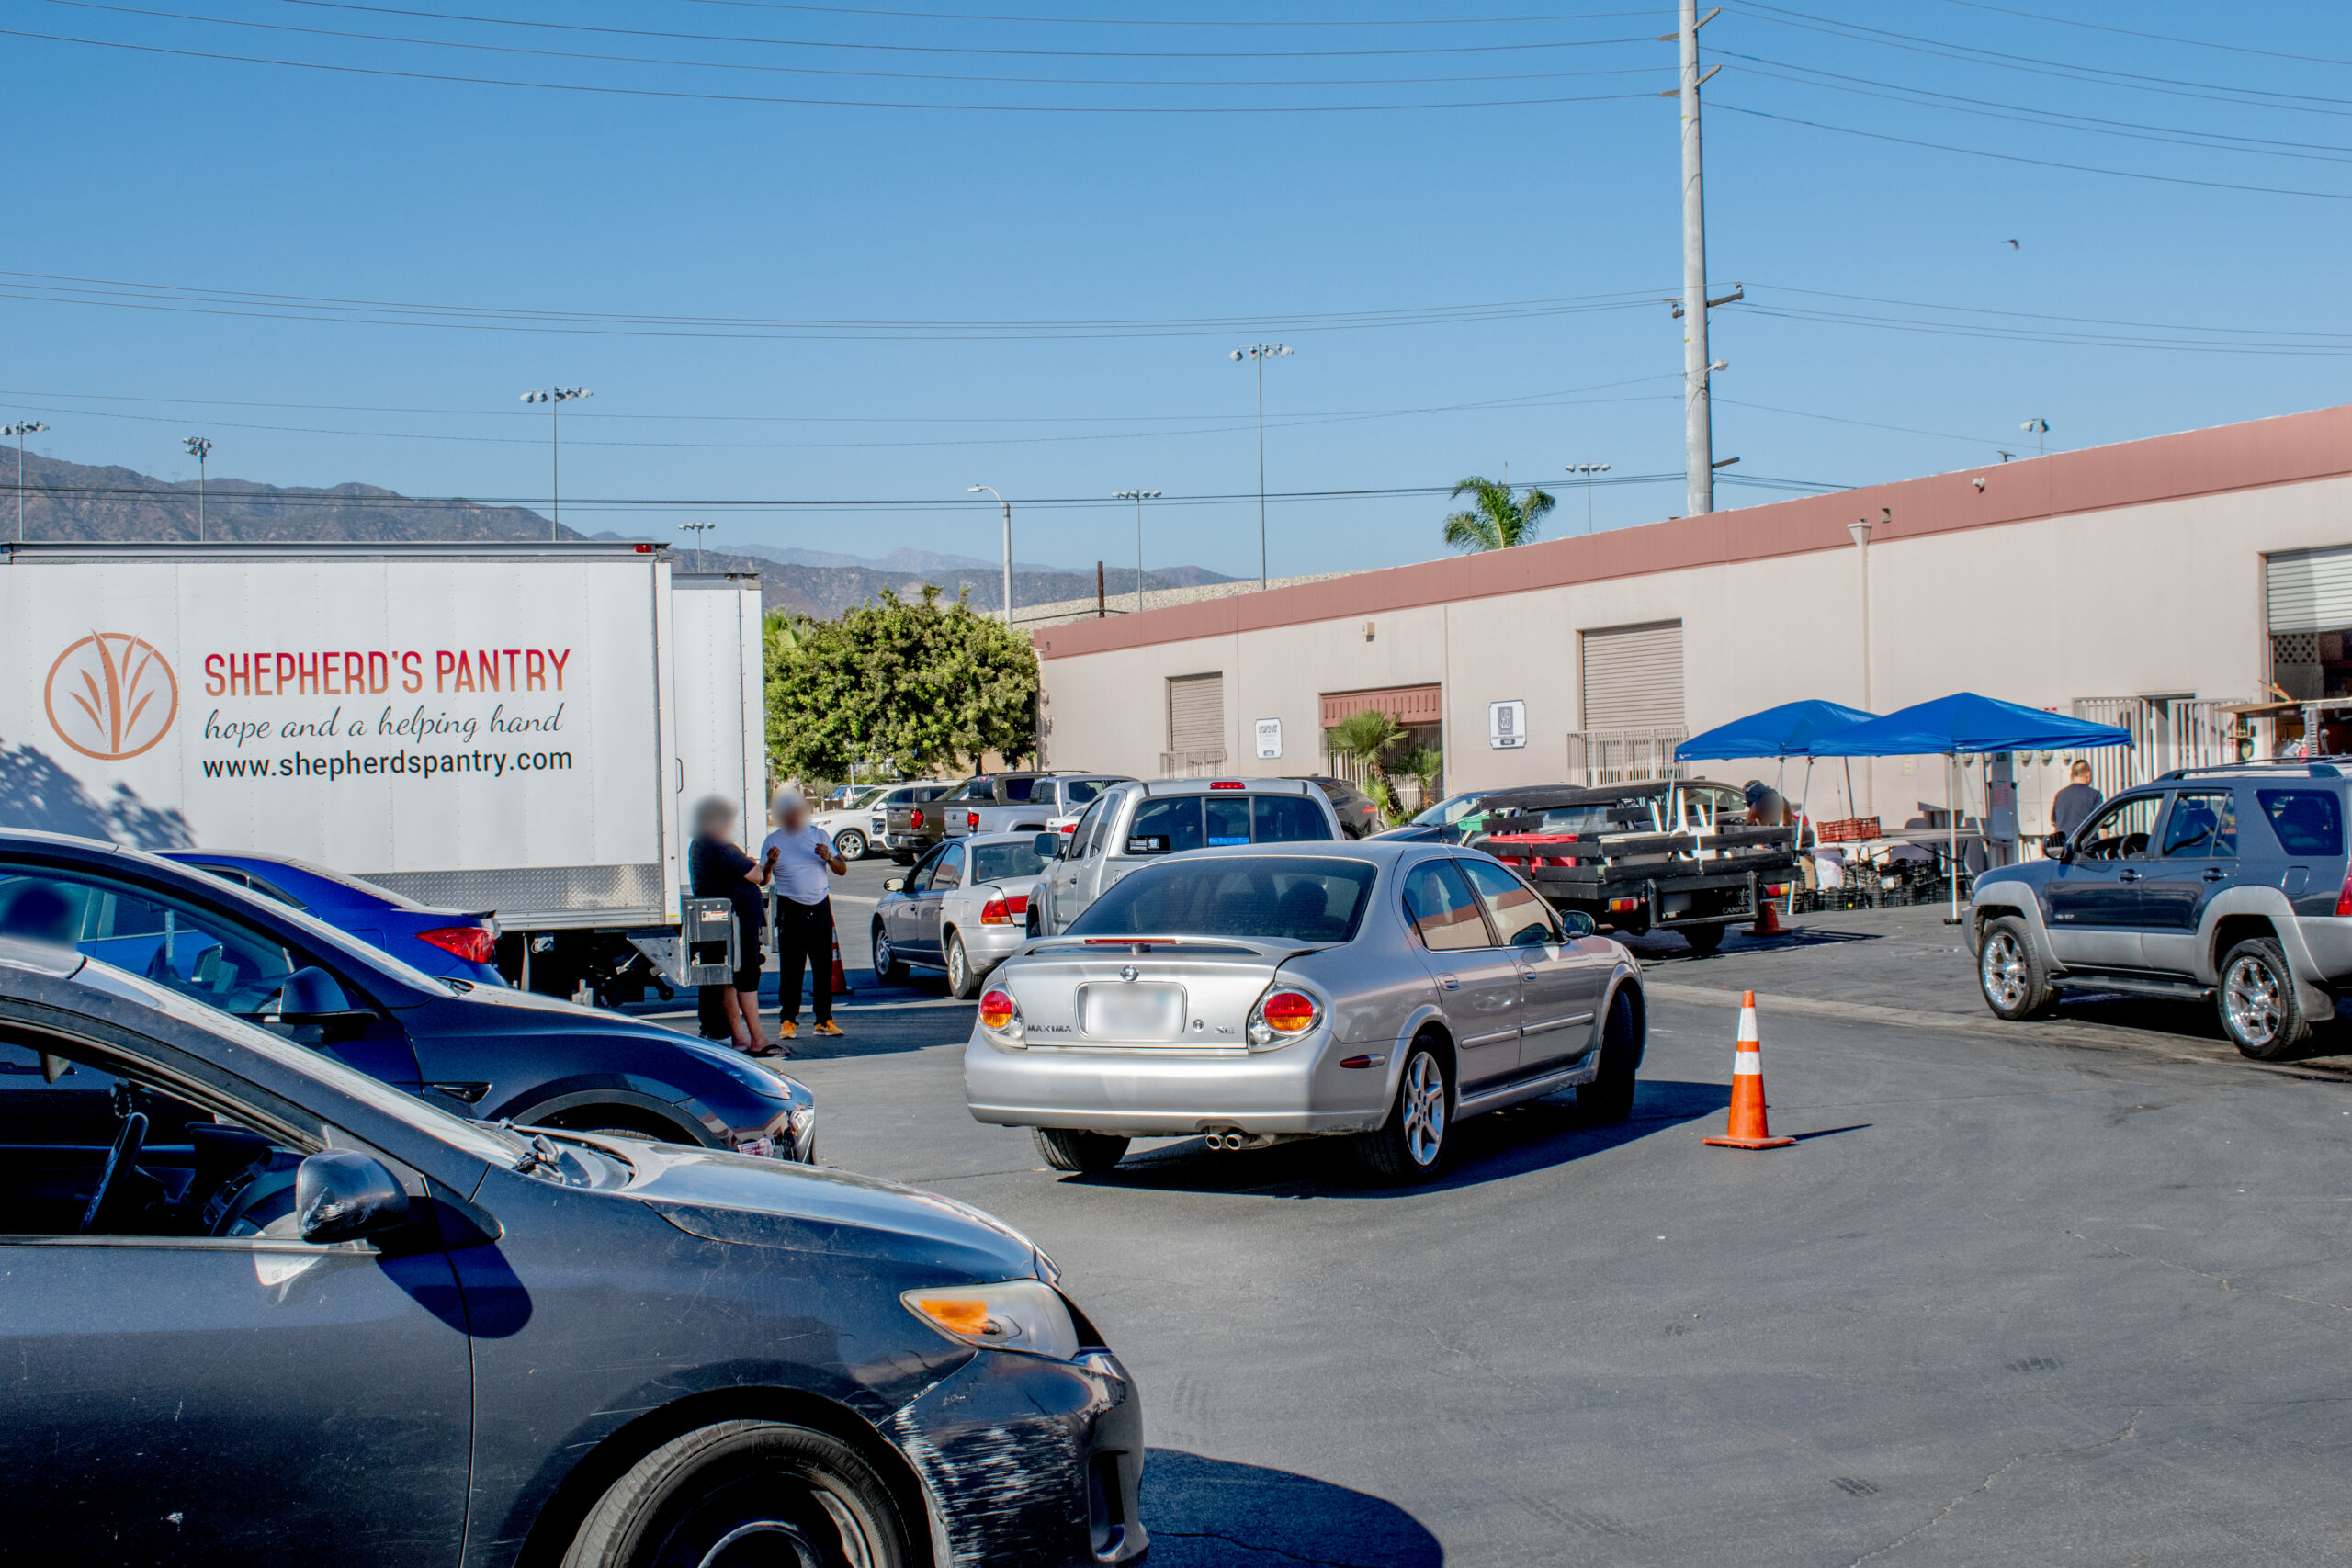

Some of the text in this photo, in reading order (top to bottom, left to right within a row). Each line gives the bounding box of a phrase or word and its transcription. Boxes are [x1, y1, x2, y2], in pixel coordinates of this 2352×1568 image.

[205, 649, 571, 696] SHEPHERD'S PANTRY
[204, 702, 566, 748] hope and a helping hand
[202, 749, 572, 781] www.shepherdspantry.com
[1027, 1023, 1072, 1032] MAXIMA
